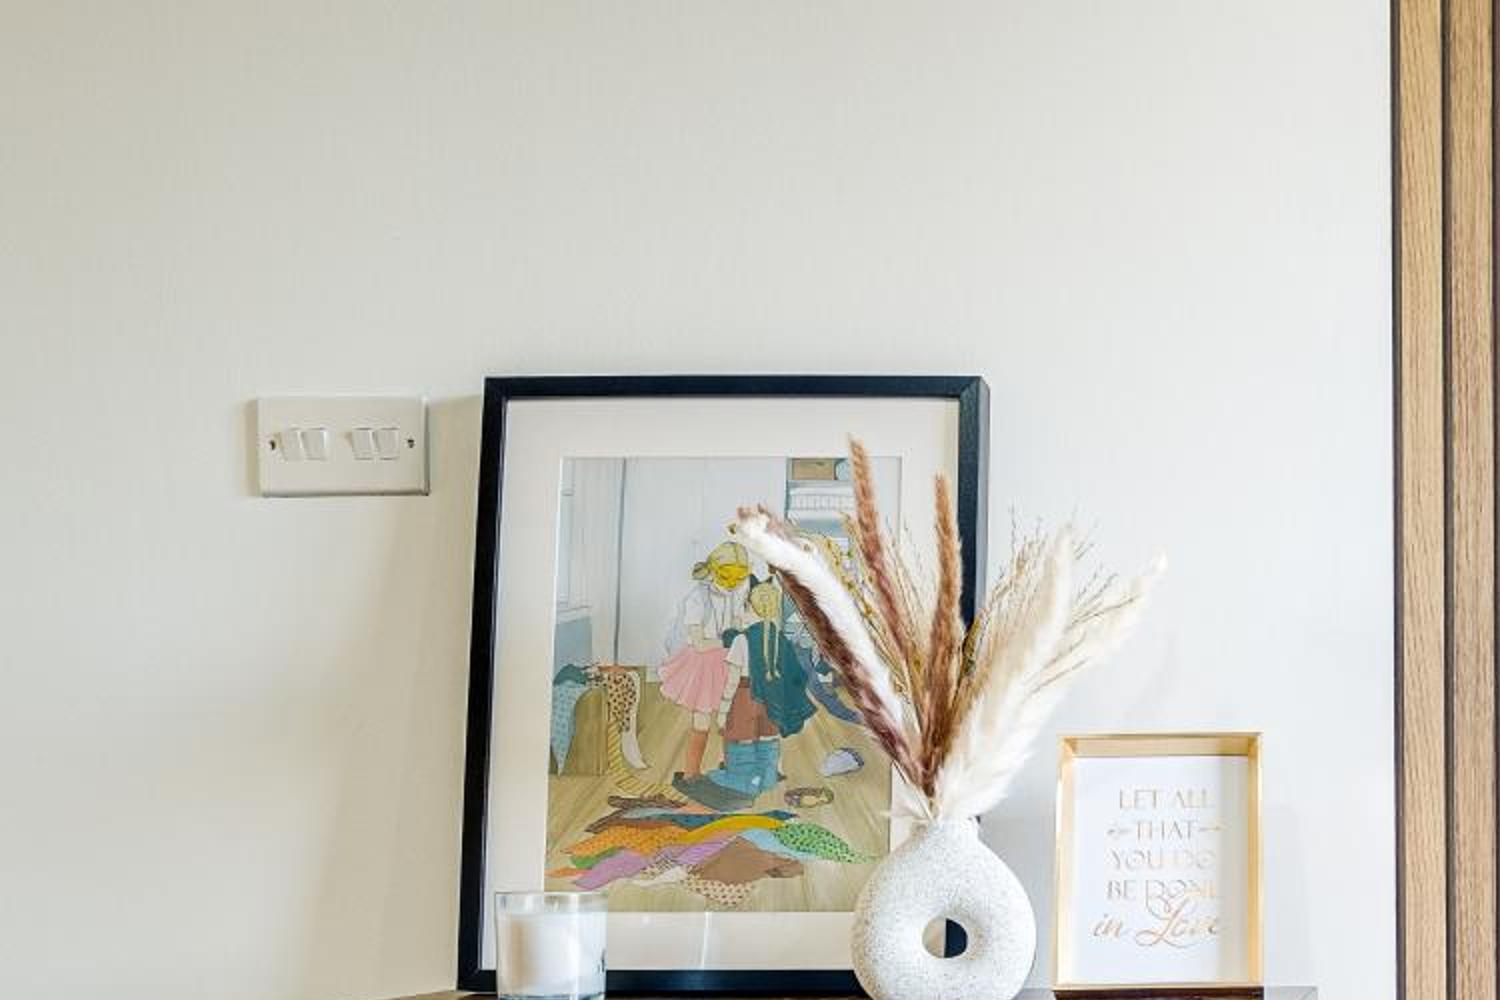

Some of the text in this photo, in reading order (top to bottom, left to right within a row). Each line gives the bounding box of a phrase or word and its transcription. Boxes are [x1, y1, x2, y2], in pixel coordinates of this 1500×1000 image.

[1119, 789, 1216, 810] LET ALL
[1136, 819, 1197, 841] THAT
[1107, 849, 1165, 870] YOU
[1107, 879, 1137, 900] BE
[1092, 913, 1125, 938] in
